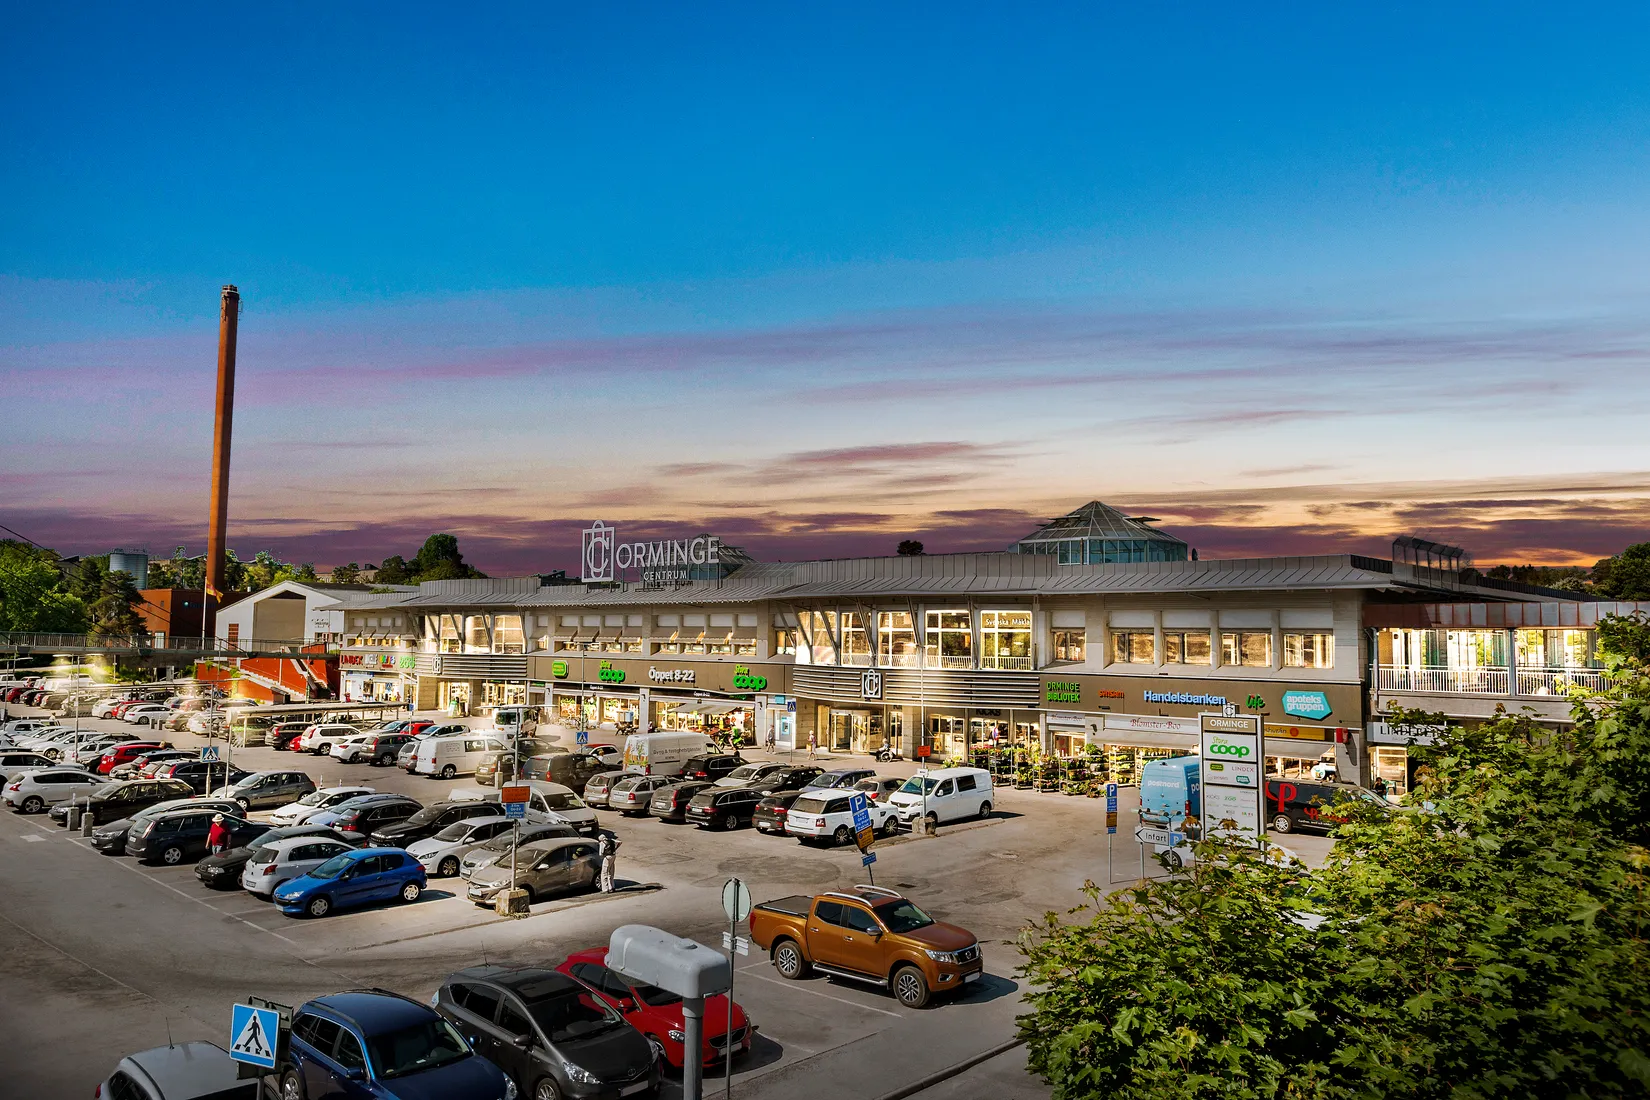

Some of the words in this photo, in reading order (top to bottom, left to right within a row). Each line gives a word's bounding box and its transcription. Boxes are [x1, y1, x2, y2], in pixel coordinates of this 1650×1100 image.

[616, 536, 720, 569] ORMINGE
[643, 570, 687, 580] CENTRUM
[598, 669, 625, 684] coop
[648, 666, 674, 682] Öppet
[675, 669, 695, 681] 8-22
[733, 675, 767, 691] coop
[1047, 682, 1080, 692] ORMINGE
[1047, 692, 1080, 702] BIBLIOTEK
[1143, 690, 1227, 706] Handelsbanken
[1286, 695, 1322, 704] apoteks
[1286, 702, 1325, 712] gruppen
[976, 708, 1002, 717] KICKS
[1130, 718, 1181, 730] Blomster-Boo
[1210, 719, 1249, 729] ORMINGE
[1212, 736, 1228, 744] Stora
[1210, 744, 1250, 758] coop
[1147, 780, 1180, 789] postnord
[1109, 785, 1115, 796] P
[855, 796, 863, 811] P
[1145, 832, 1167, 842] Infart
[1173, 836, 1180, 844] P
